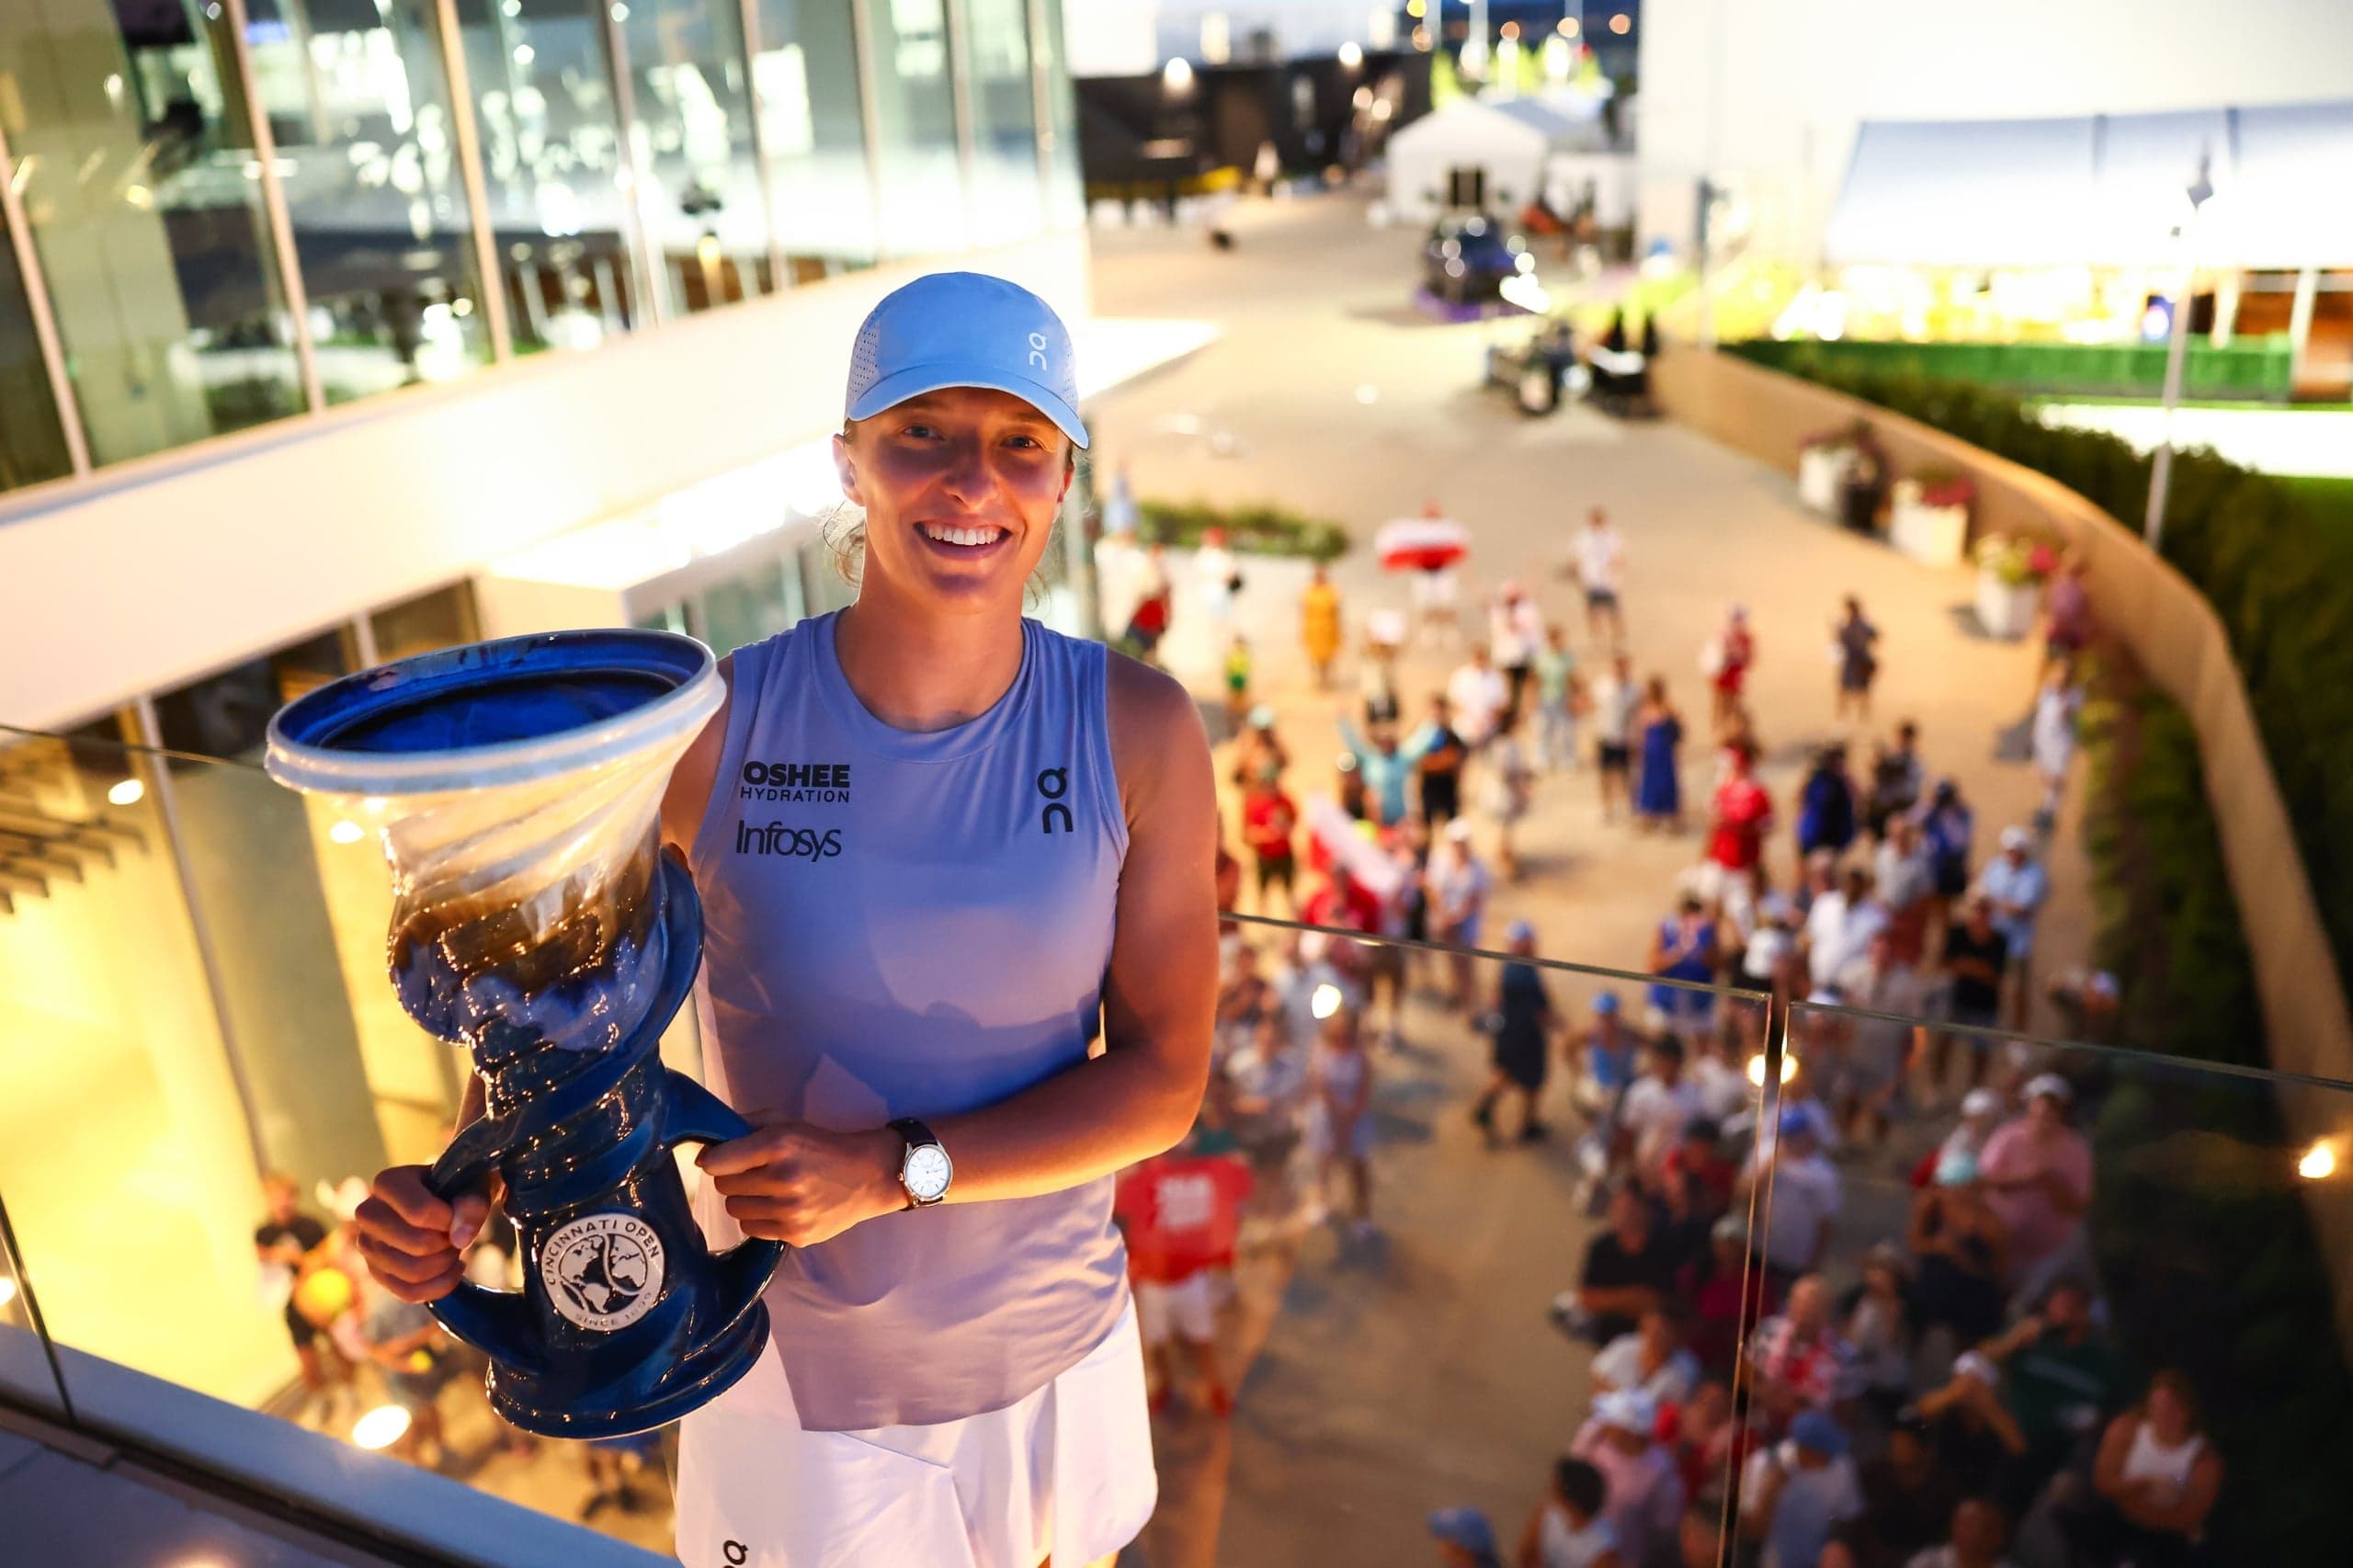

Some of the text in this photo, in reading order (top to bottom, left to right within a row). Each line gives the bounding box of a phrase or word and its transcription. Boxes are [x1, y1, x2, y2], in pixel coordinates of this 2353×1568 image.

[743, 761, 850, 789] OSHEE
[740, 786, 850, 803] HYDRATION
[735, 820, 842, 862] Infosys
[544, 1219, 660, 1286] CINCINNATI OPEN
[575, 1312, 618, 1327] SINCE
